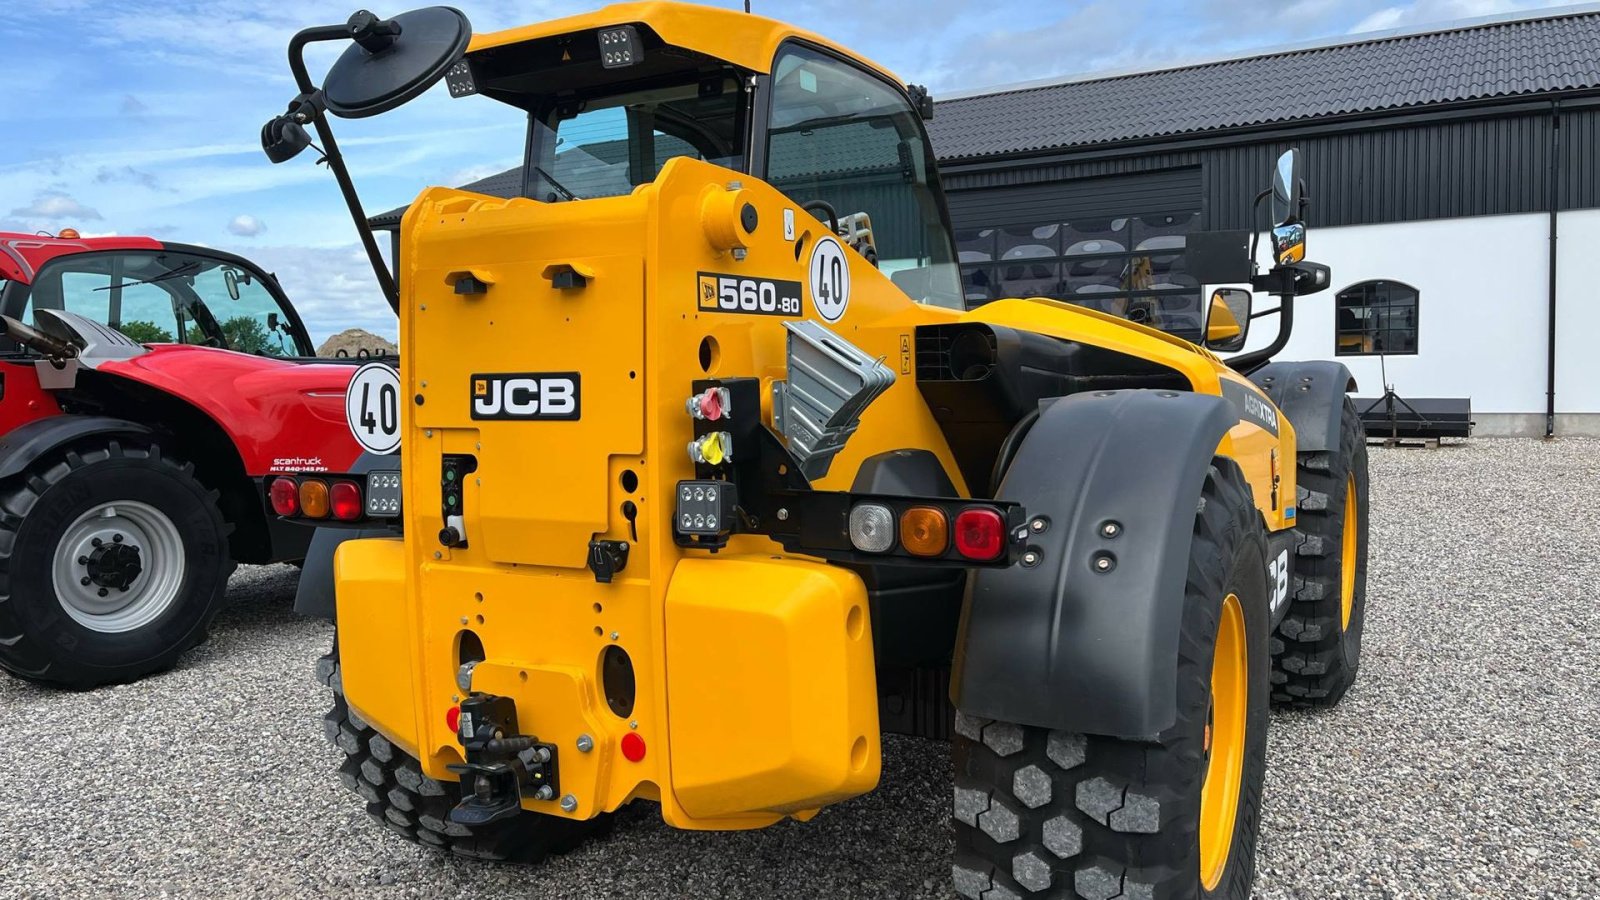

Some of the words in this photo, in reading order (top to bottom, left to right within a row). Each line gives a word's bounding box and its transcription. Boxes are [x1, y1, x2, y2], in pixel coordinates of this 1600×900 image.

[819, 254, 843, 305] 40
[360, 382, 397, 435] 40
[475, 378, 575, 415] JCB
[273, 456, 322, 466] scantruck
